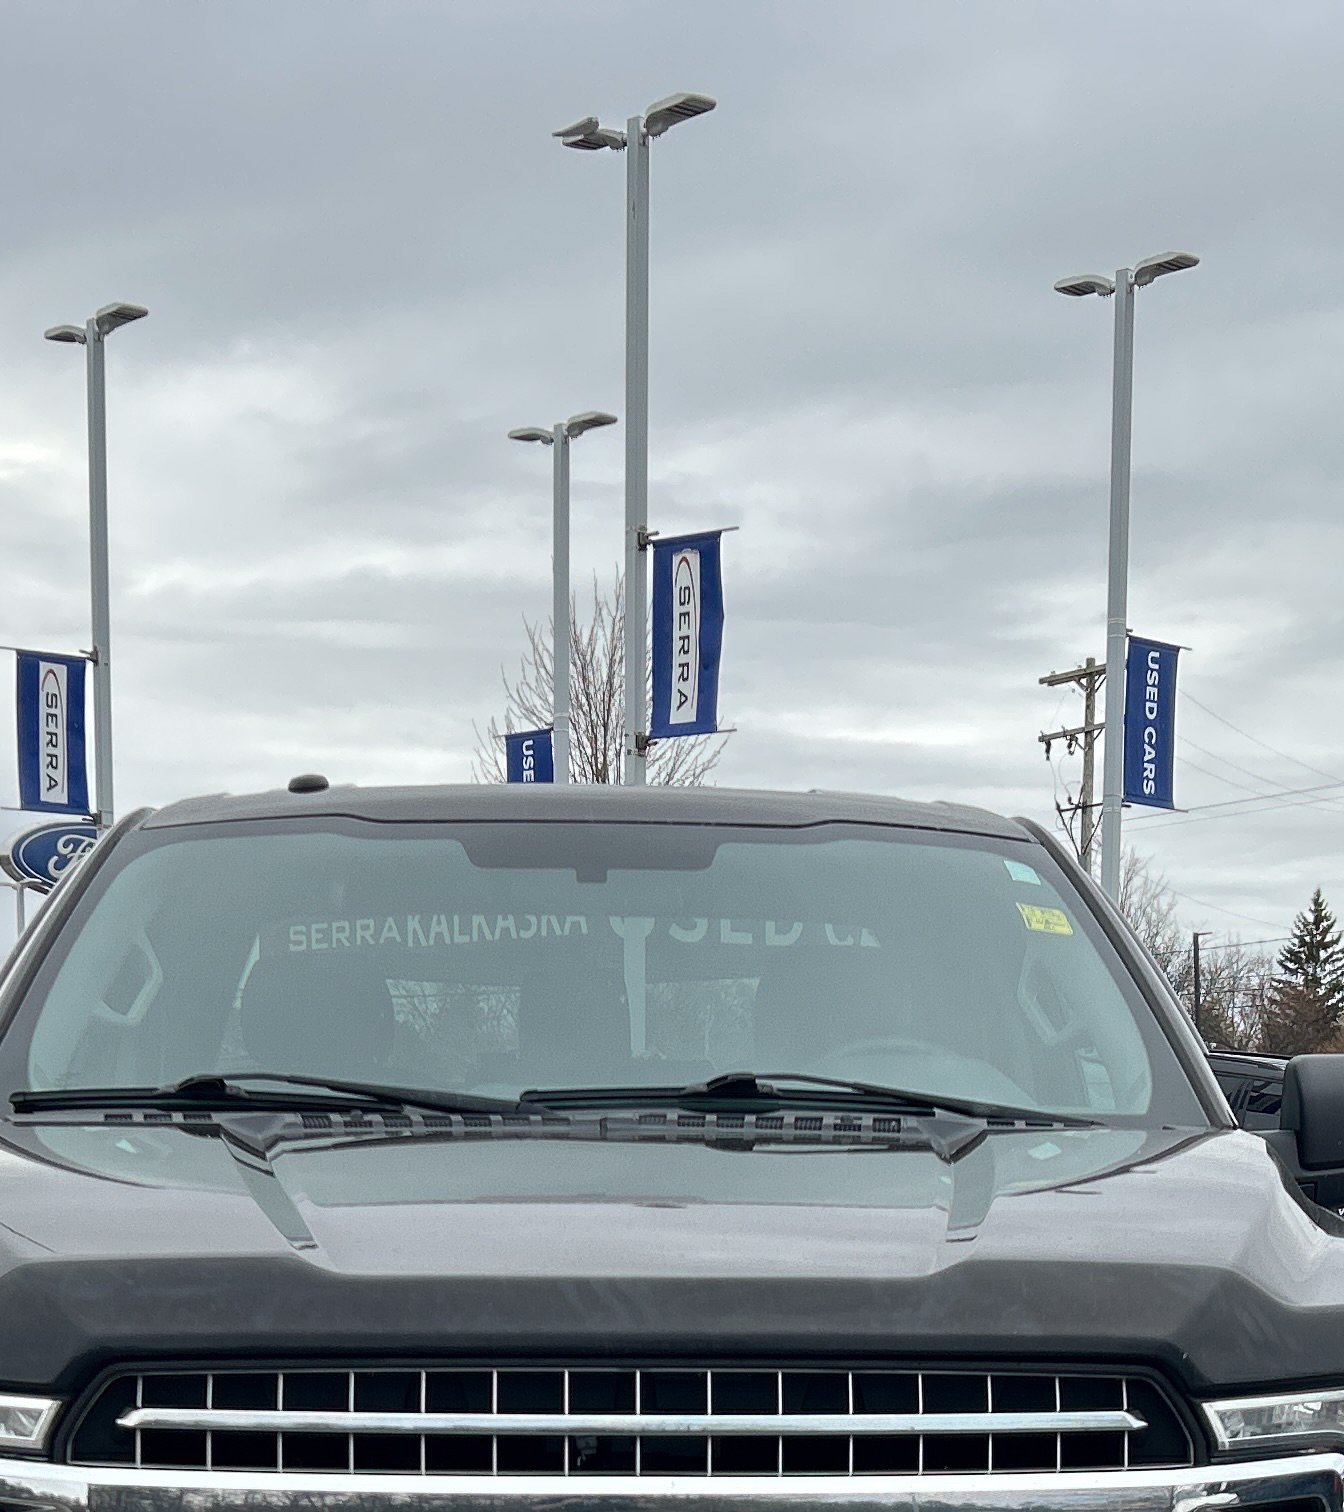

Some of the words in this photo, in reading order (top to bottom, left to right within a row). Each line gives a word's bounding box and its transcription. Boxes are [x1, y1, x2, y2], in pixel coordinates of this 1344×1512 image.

[675, 585, 691, 711] SERRA
[1146, 650, 1160, 720] USED
[45, 691, 59, 793] SERRA
[1142, 727, 1157, 796] CARS
